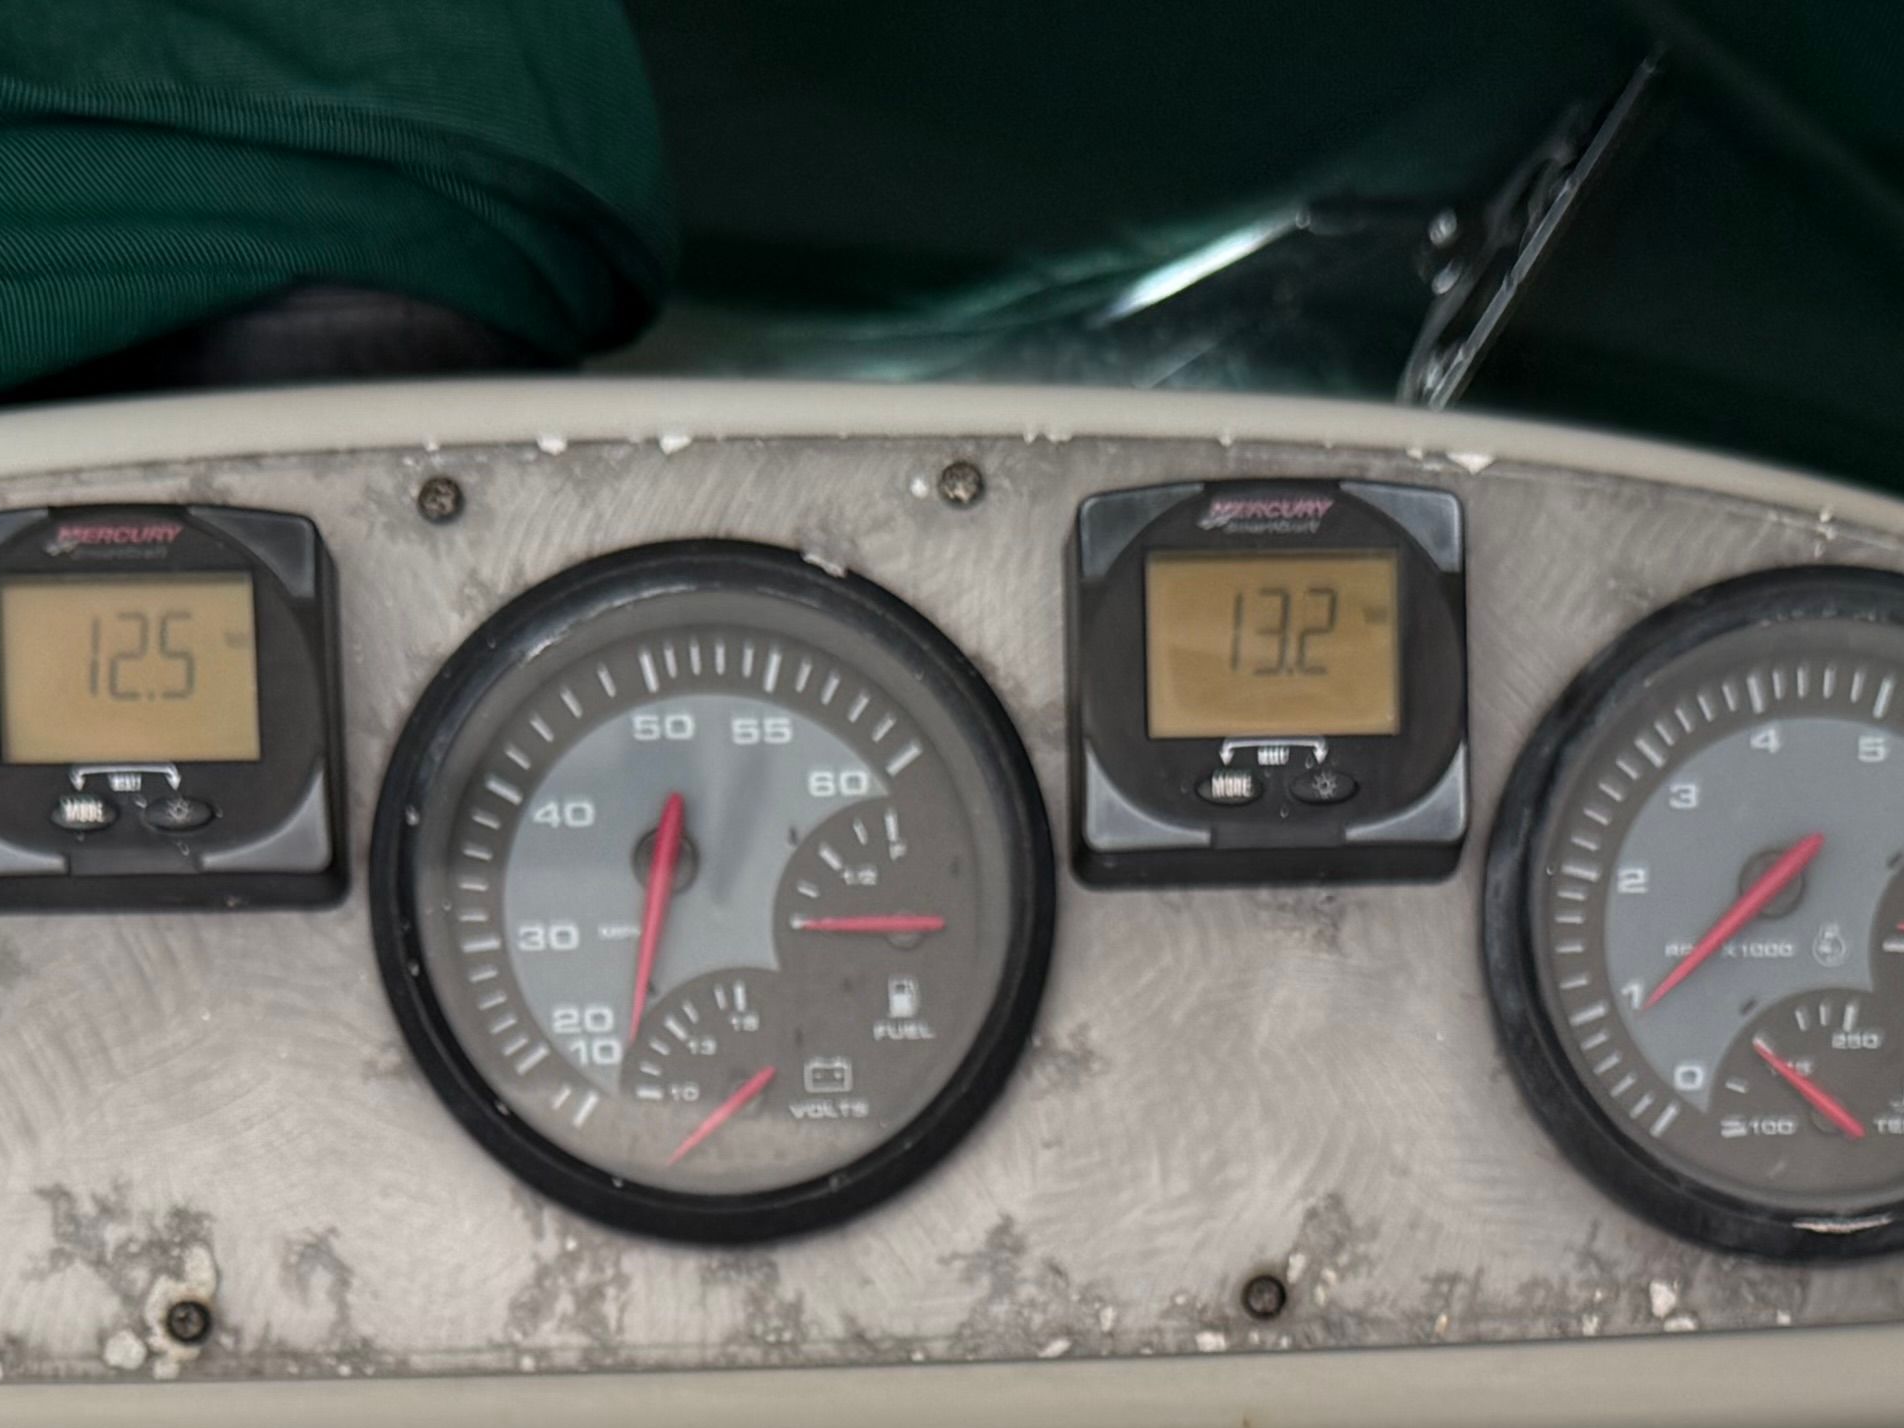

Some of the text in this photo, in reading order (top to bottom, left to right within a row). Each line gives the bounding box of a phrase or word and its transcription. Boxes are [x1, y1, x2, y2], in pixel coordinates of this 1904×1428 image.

[1210, 498, 1335, 518] MERCURY
[56, 522, 184, 543] MERCURY
[1230, 586, 1339, 676] 13.2
[88, 612, 196, 700] 12.5
[632, 714, 694, 741] 50
[731, 717, 791, 745] 55
[1749, 729, 1780, 753] 4
[1857, 735, 1889, 763] 5
[808, 770, 869, 797] 60
[1668, 783, 1698, 809] 3
[533, 801, 594, 828] 40
[1616, 867, 1647, 894] 2
[518, 923, 579, 951] 30
[1622, 983, 1644, 1008] 1
[553, 1005, 613, 1033] 20
[873, 1020, 936, 1041] FUEL
[570, 1037, 622, 1065] 10
[1673, 1064, 1704, 1091] 0
[789, 1100, 869, 1119] VOLTS
